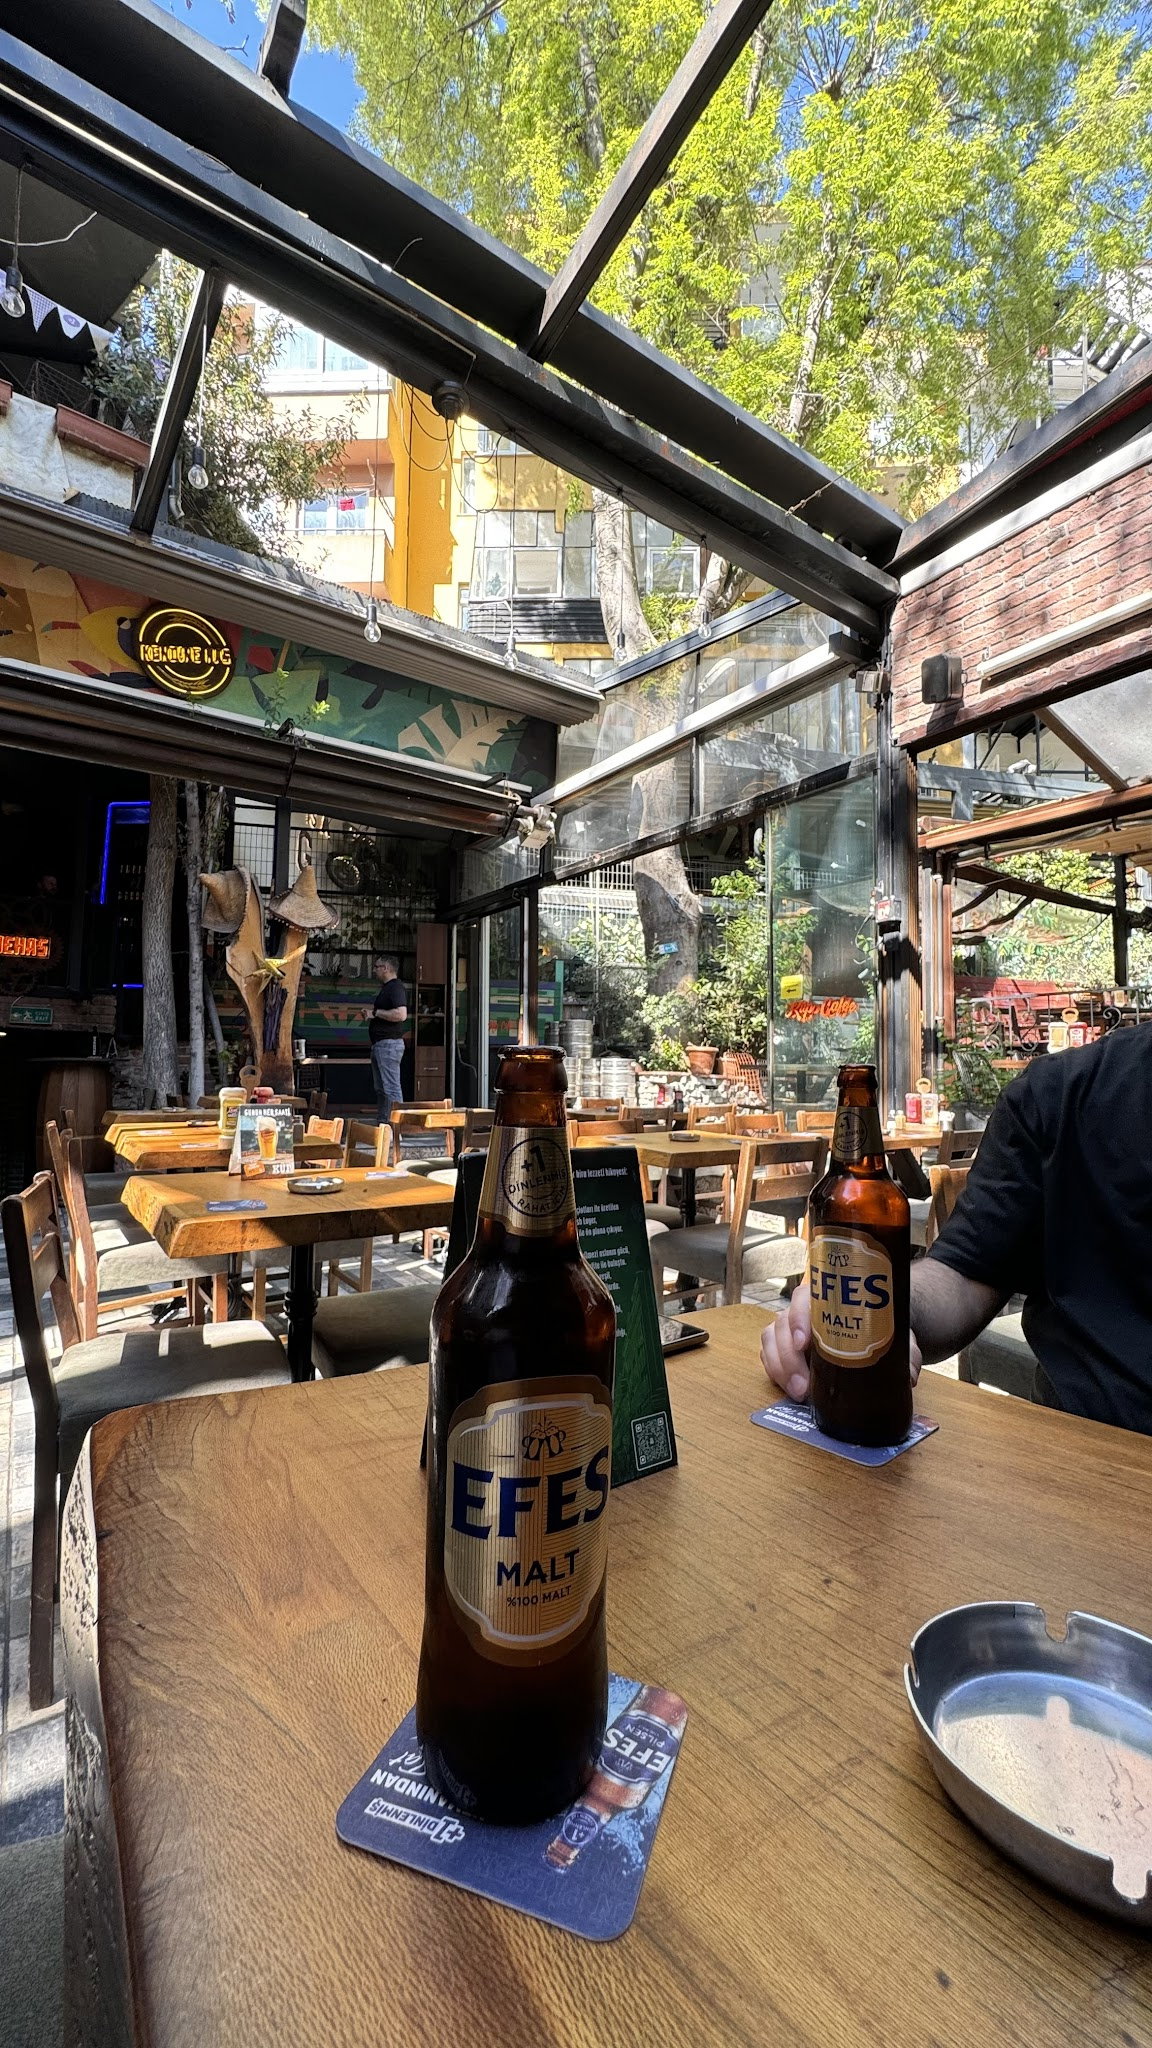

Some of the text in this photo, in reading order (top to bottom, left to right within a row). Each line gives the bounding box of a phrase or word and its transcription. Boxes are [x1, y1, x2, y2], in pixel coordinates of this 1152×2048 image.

[521, 1145, 545, 1172] +1
[518, 1198, 551, 1212] RAHAT
[810, 1265, 890, 1310] EFES
[822, 1311, 863, 1330] MALT
[841, 1331, 859, 1340] MALT
[451, 1445, 609, 1540] EFES
[496, 1548, 580, 1587] MALT
[506, 1585, 572, 1607] %100 MALT
[603, 1728, 671, 1774] EFES
[366, 1800, 464, 1842] +1 DİNLENMİŞ
